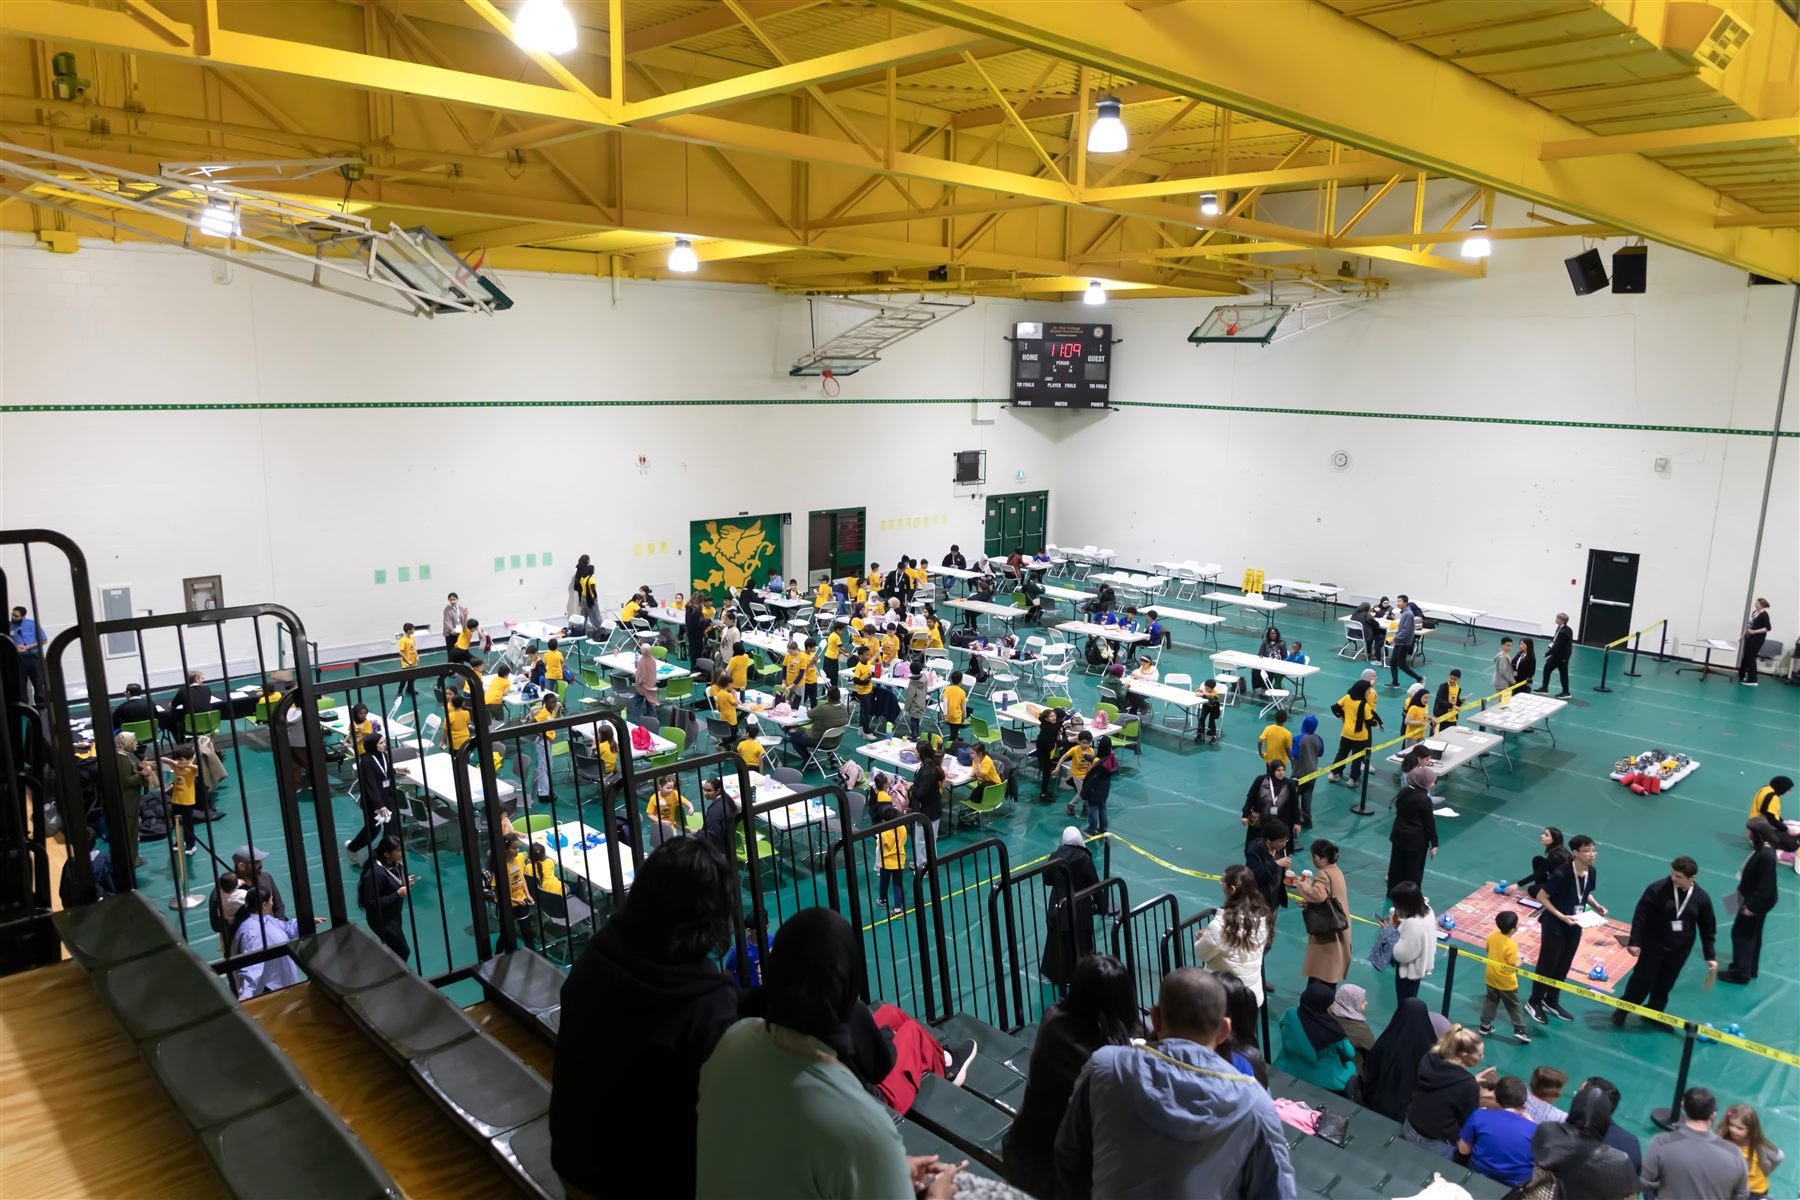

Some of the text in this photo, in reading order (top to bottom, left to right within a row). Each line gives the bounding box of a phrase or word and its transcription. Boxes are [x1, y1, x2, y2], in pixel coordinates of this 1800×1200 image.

[1051, 343, 1081, 358] 11:09
[1538, 976, 1557, 985] CAUTION
[1577, 988, 1596, 998] CAUTION
[1616, 1000, 1636, 1011] CAUTION
[1658, 1013, 1678, 1025] CAUTION
[1701, 1027, 1767, 1054] CAUTION CAUTION
